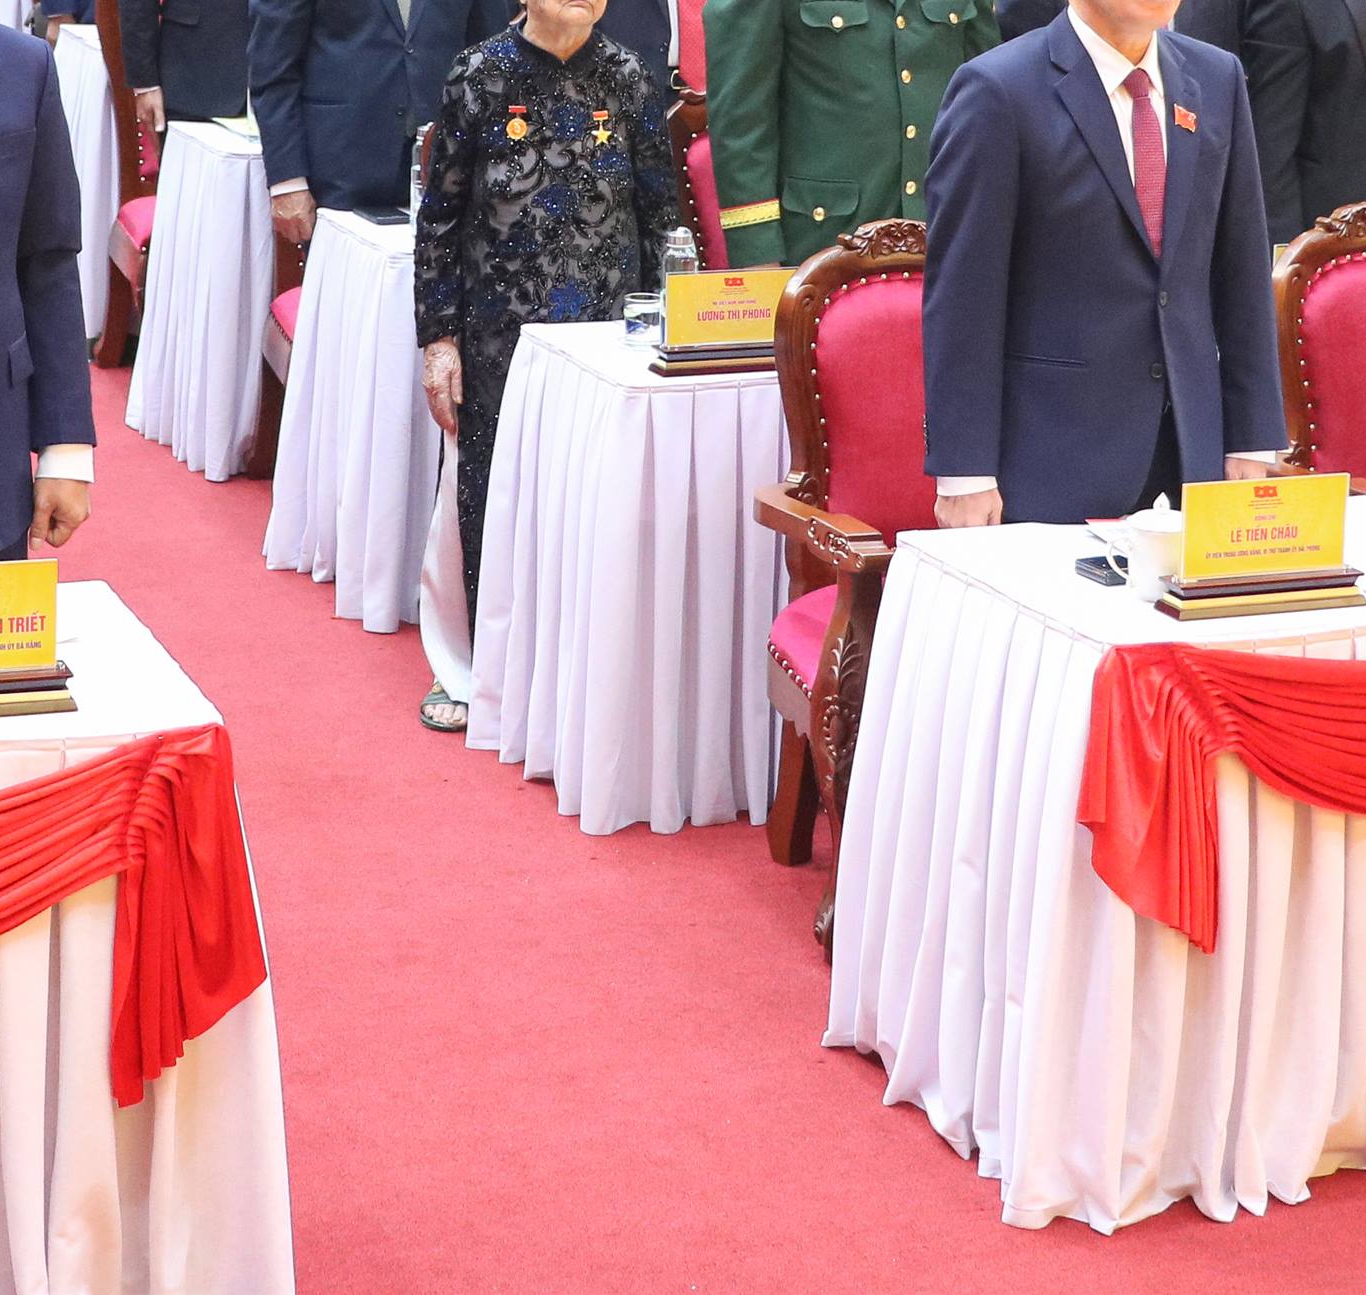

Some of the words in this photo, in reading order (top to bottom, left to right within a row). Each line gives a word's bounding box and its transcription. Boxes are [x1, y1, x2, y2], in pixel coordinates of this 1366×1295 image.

[1230, 528, 1242, 543] LÊ
[1245, 524, 1268, 542] TIẾN
[1271, 523, 1298, 540] CHÂU
[8, 611, 47, 633] TRIẾT
